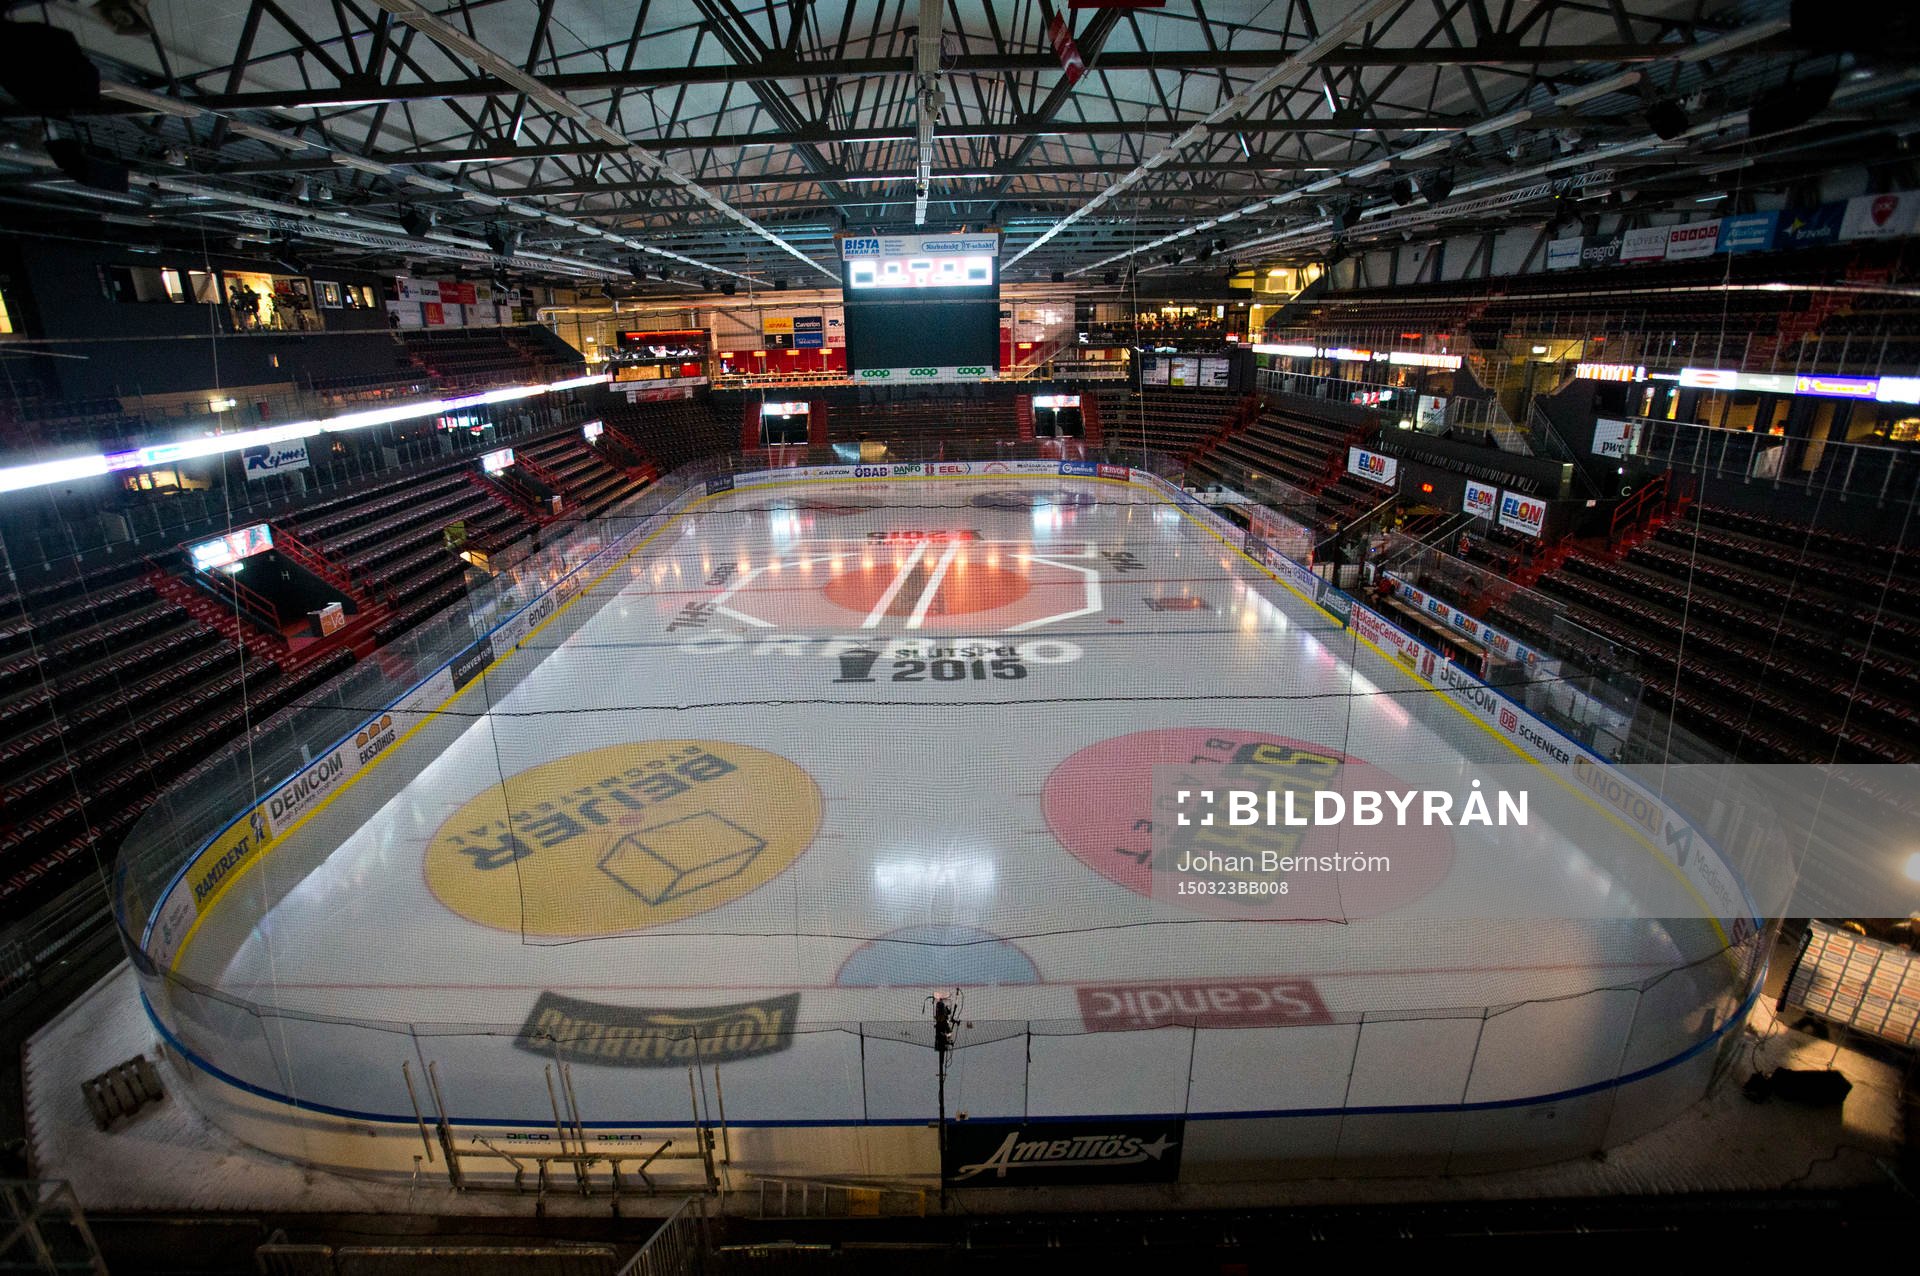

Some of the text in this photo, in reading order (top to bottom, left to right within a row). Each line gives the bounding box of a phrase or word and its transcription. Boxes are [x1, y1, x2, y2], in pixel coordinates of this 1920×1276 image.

[1670, 226, 1718, 242] CRAMO
[844, 239, 880, 249] BISTA
[861, 370, 890, 379] coop
[909, 368, 938, 377] coop
[957, 367, 986, 376] coop
[1601, 440, 1625, 455] pwc
[855, 465, 888, 478] ÖBAB
[893, 464, 921, 475] DANFO
[939, 466, 963, 474] EEL
[1358, 452, 1386, 476] ELON
[1467, 487, 1493, 506] ELON
[1502, 497, 1543, 526] ELON
[1404, 586, 1424, 605] ELON
[1428, 600, 1449, 619] ELON
[1454, 613, 1478, 636] ELON
[1406, 641, 1420, 658] AB
[1483, 630, 1509, 652] ELON
[1516, 646, 1536, 665] ELO
[892, 659, 1027, 683] 2015
[1440, 667, 1497, 716] DEMCOM
[1502, 712, 1516, 730] DB
[1519, 725, 1570, 765] SCHENKER
[271, 752, 343, 819] DEMCOM
[1577, 760, 1661, 835] LINOTOL
[459, 753, 737, 871] BEIJER
[194, 837, 250, 903] RAMIRENT
[1092, 984, 1312, 1025] Scandic
